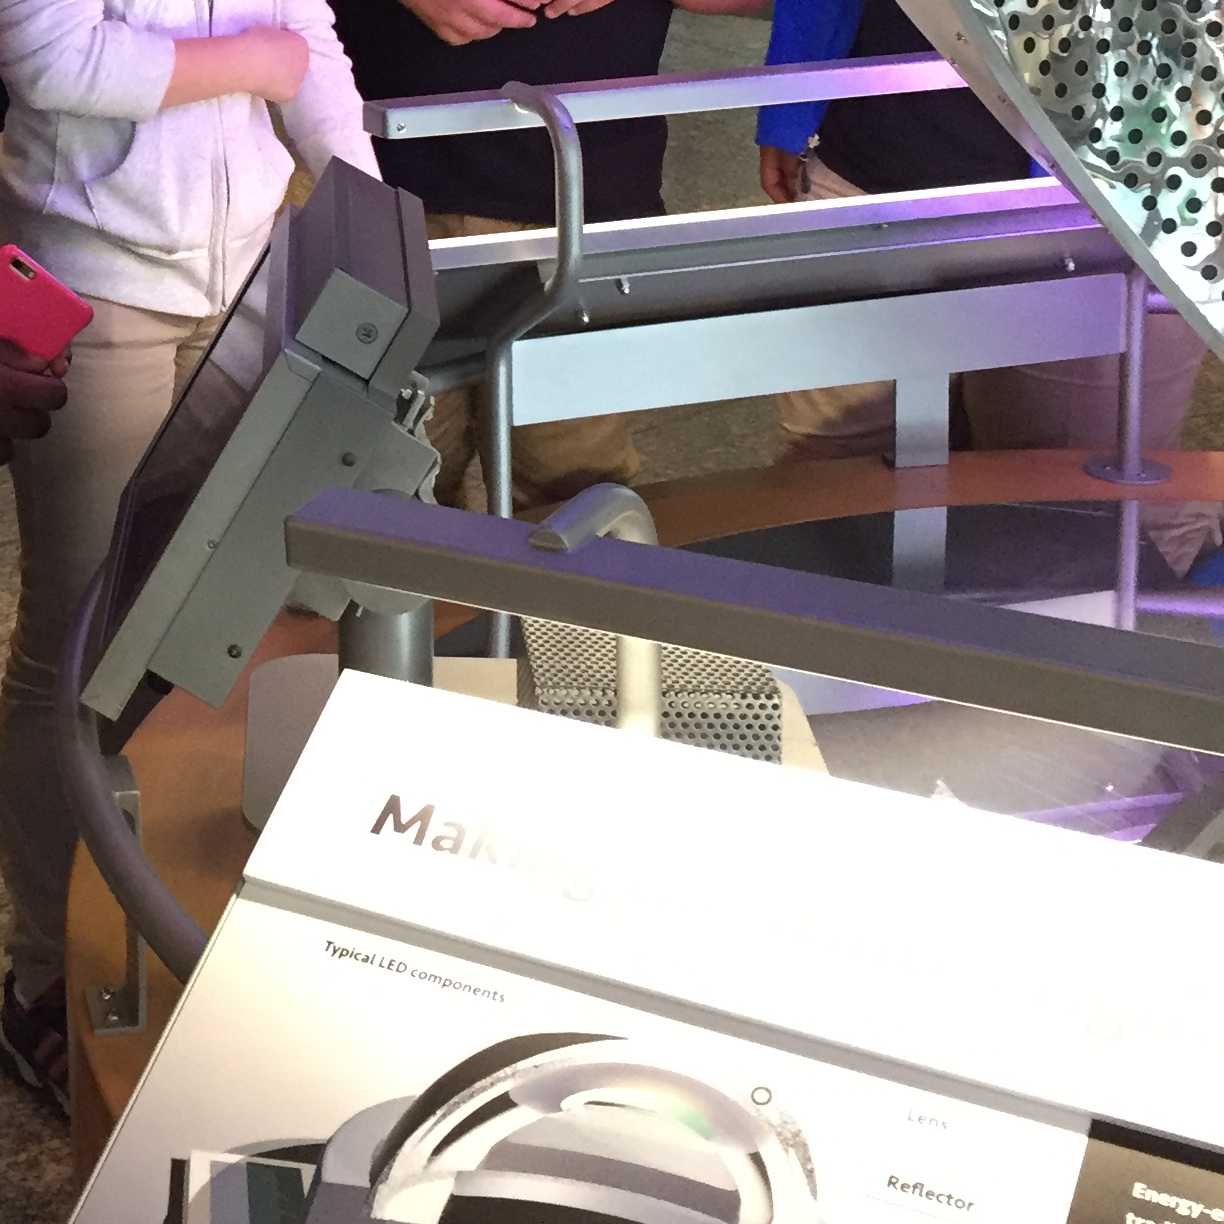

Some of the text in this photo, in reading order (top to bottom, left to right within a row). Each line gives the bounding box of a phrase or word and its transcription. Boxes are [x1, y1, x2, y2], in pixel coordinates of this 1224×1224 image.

[324, 940, 506, 1004] Typical LED components
[907, 1109, 949, 1131] Lens
[886, 1174, 976, 1213] Reflector
